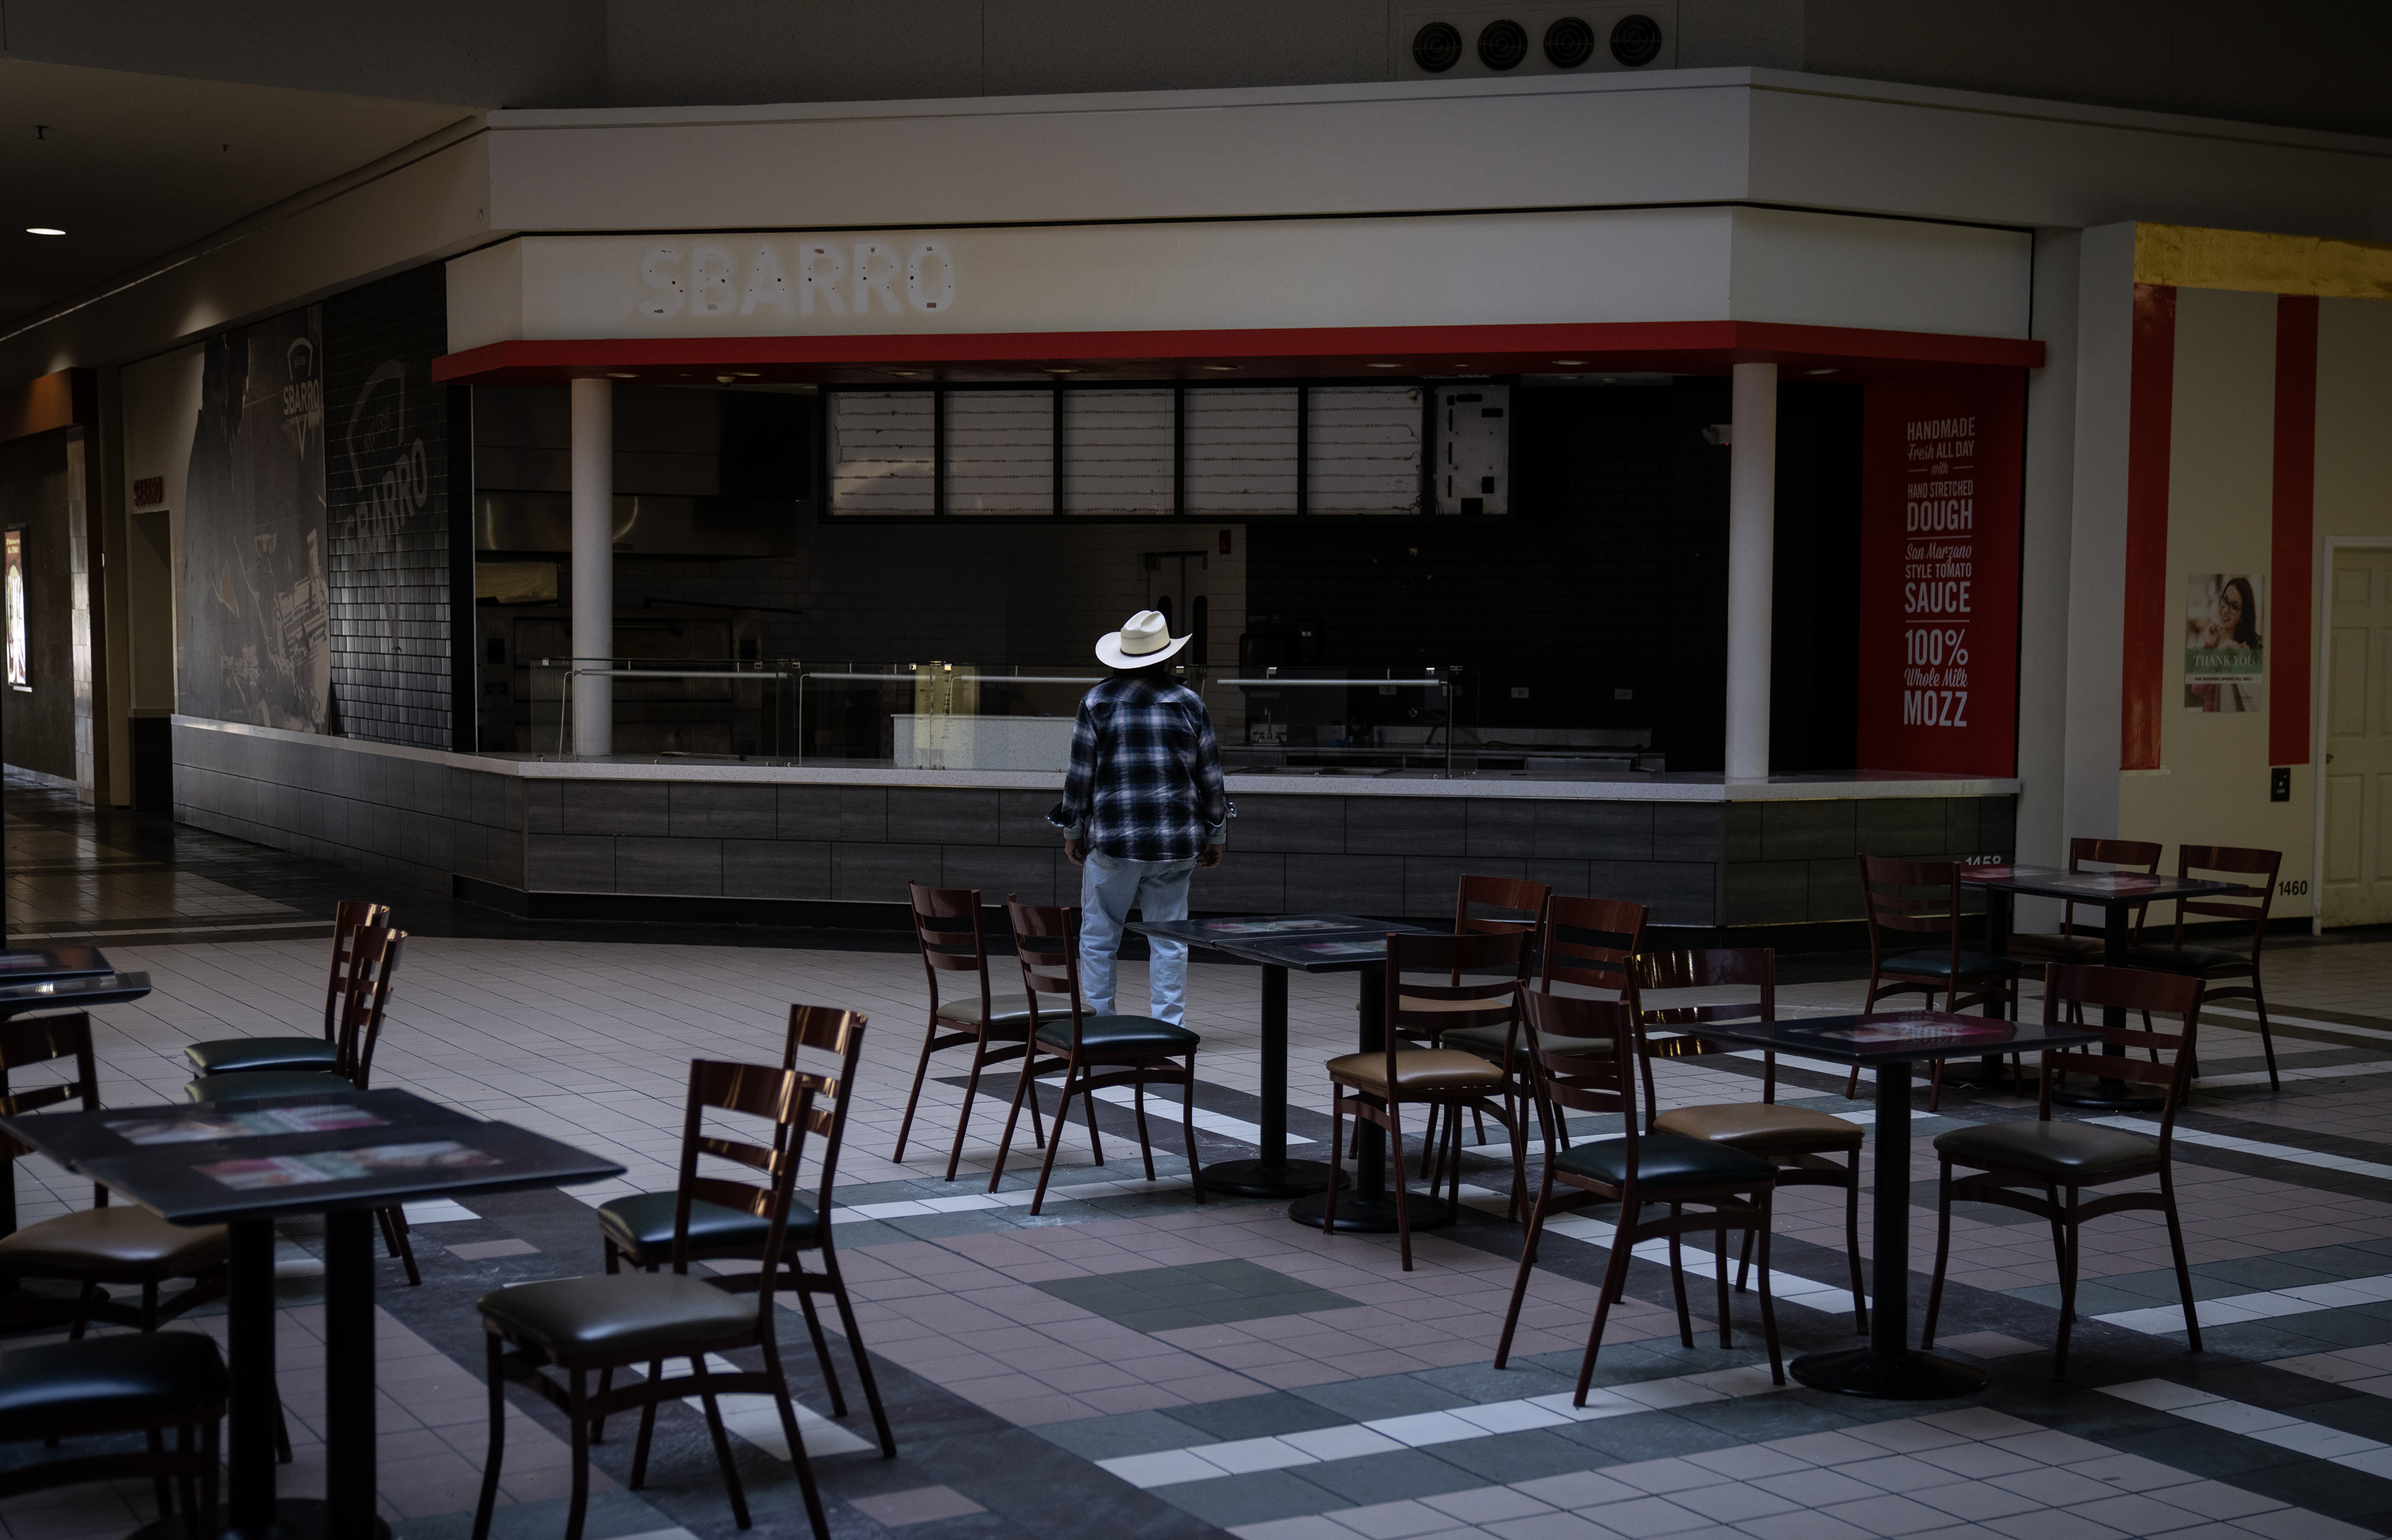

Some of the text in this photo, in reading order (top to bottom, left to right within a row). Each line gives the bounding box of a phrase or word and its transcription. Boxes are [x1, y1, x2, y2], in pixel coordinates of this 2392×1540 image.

[639, 241, 957, 317] SBARRO
[283, 378, 319, 416] SBARRO
[1907, 416, 1976, 442] HANDMADE
[1906, 440, 1975, 461] Fresh ALL DAY
[1931, 461, 1949, 475] with
[133, 476, 163, 507] SBARRO
[1908, 479, 1973, 499] HAND STRETCHED
[344, 437, 428, 581] SBARRO
[1906, 499, 1973, 531] DOUGH
[1905, 542, 1972, 564] San Marzano
[1905, 562, 1972, 579] STYLE TOMATO
[1904, 580, 1971, 613] SAUCE
[1904, 628, 1969, 666] 100%
[2193, 654, 2254, 667] THANK YOU
[1903, 667, 1969, 688] Whole Milk
[1903, 690, 1967, 728] MOZZ
[2278, 881, 2308, 896] 1460
